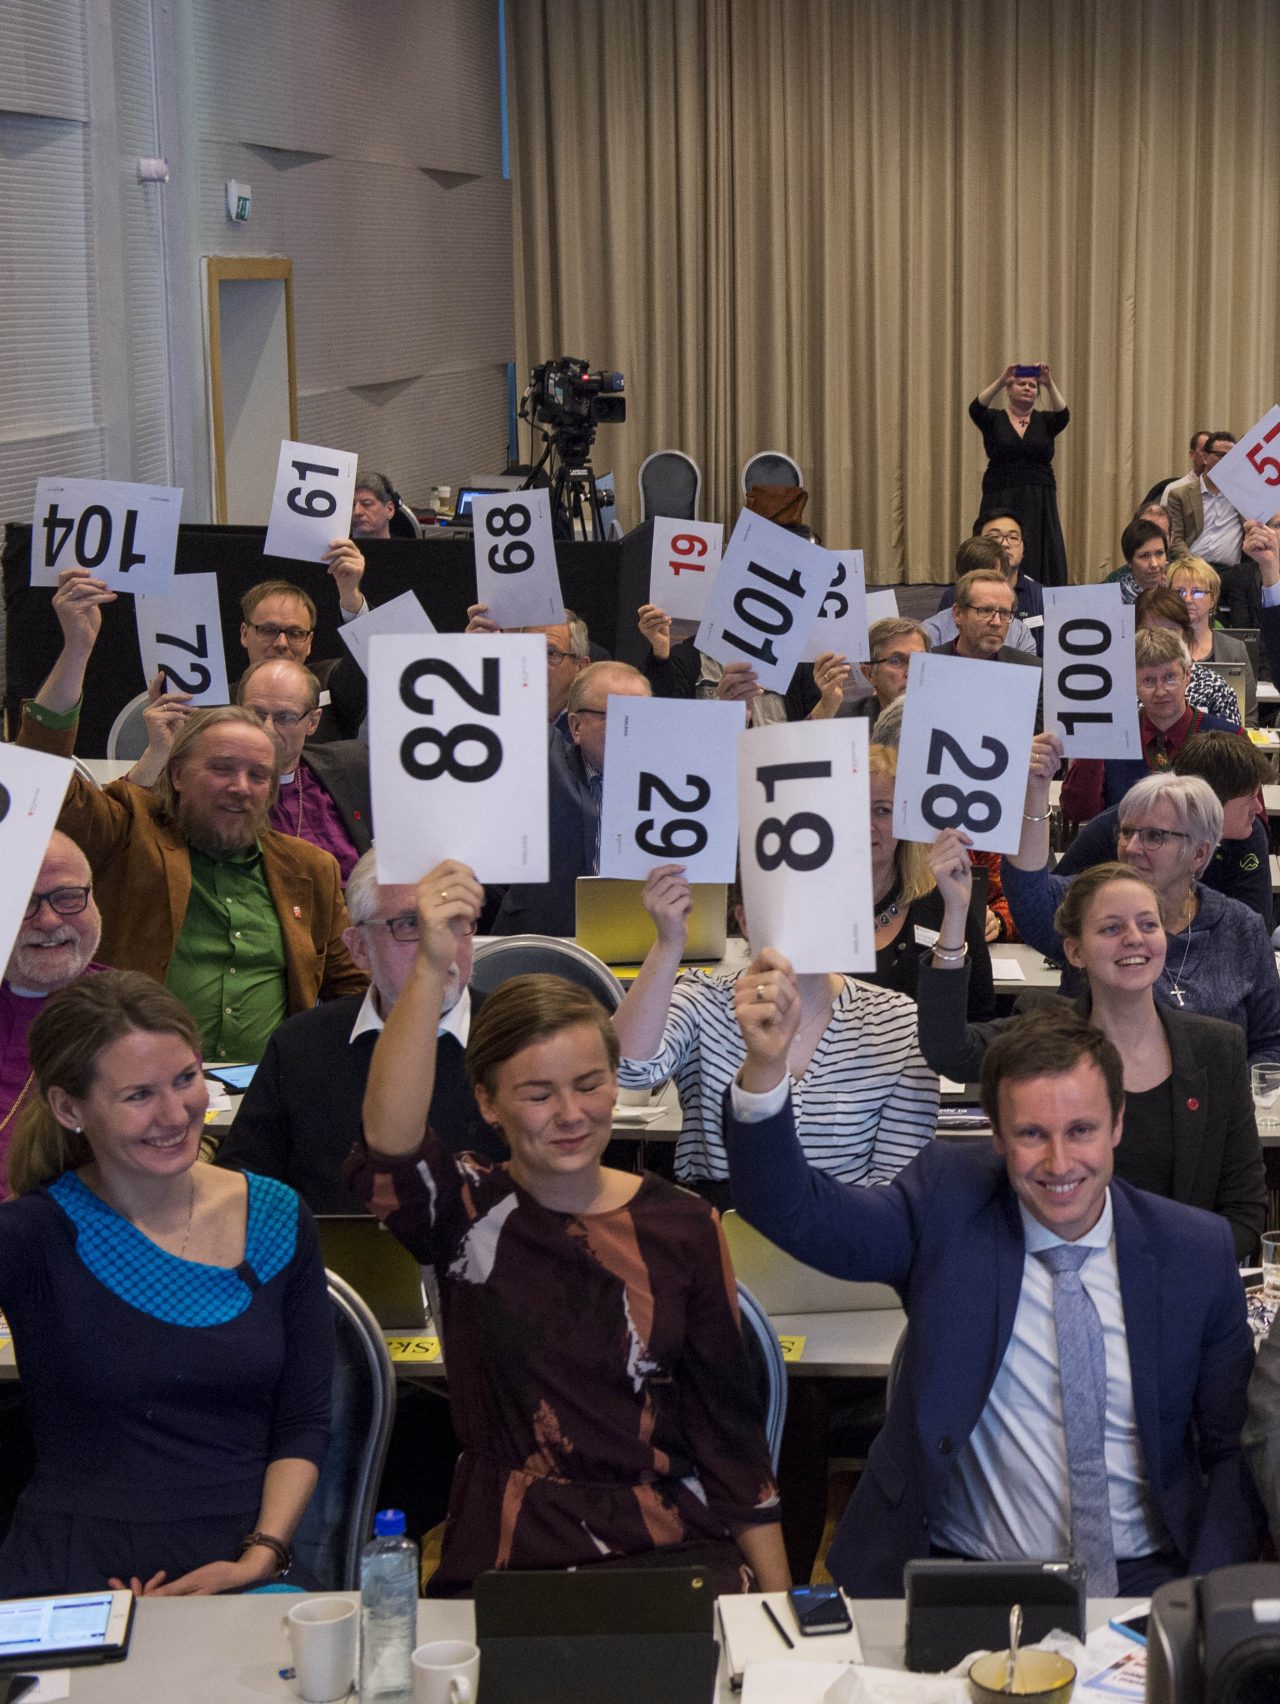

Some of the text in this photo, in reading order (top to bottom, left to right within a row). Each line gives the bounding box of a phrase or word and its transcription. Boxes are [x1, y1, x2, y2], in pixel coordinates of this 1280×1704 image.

[42, 503, 146, 573] 104
[286, 460, 339, 518] 61
[154, 624, 212, 697] 72
[721, 560, 807, 667] 101
[399, 657, 503, 783] 82
[1056, 618, 1114, 736] 100
[634, 771, 711, 858] 29
[755, 760, 834, 872] 81
[920, 728, 1009, 833] 28
